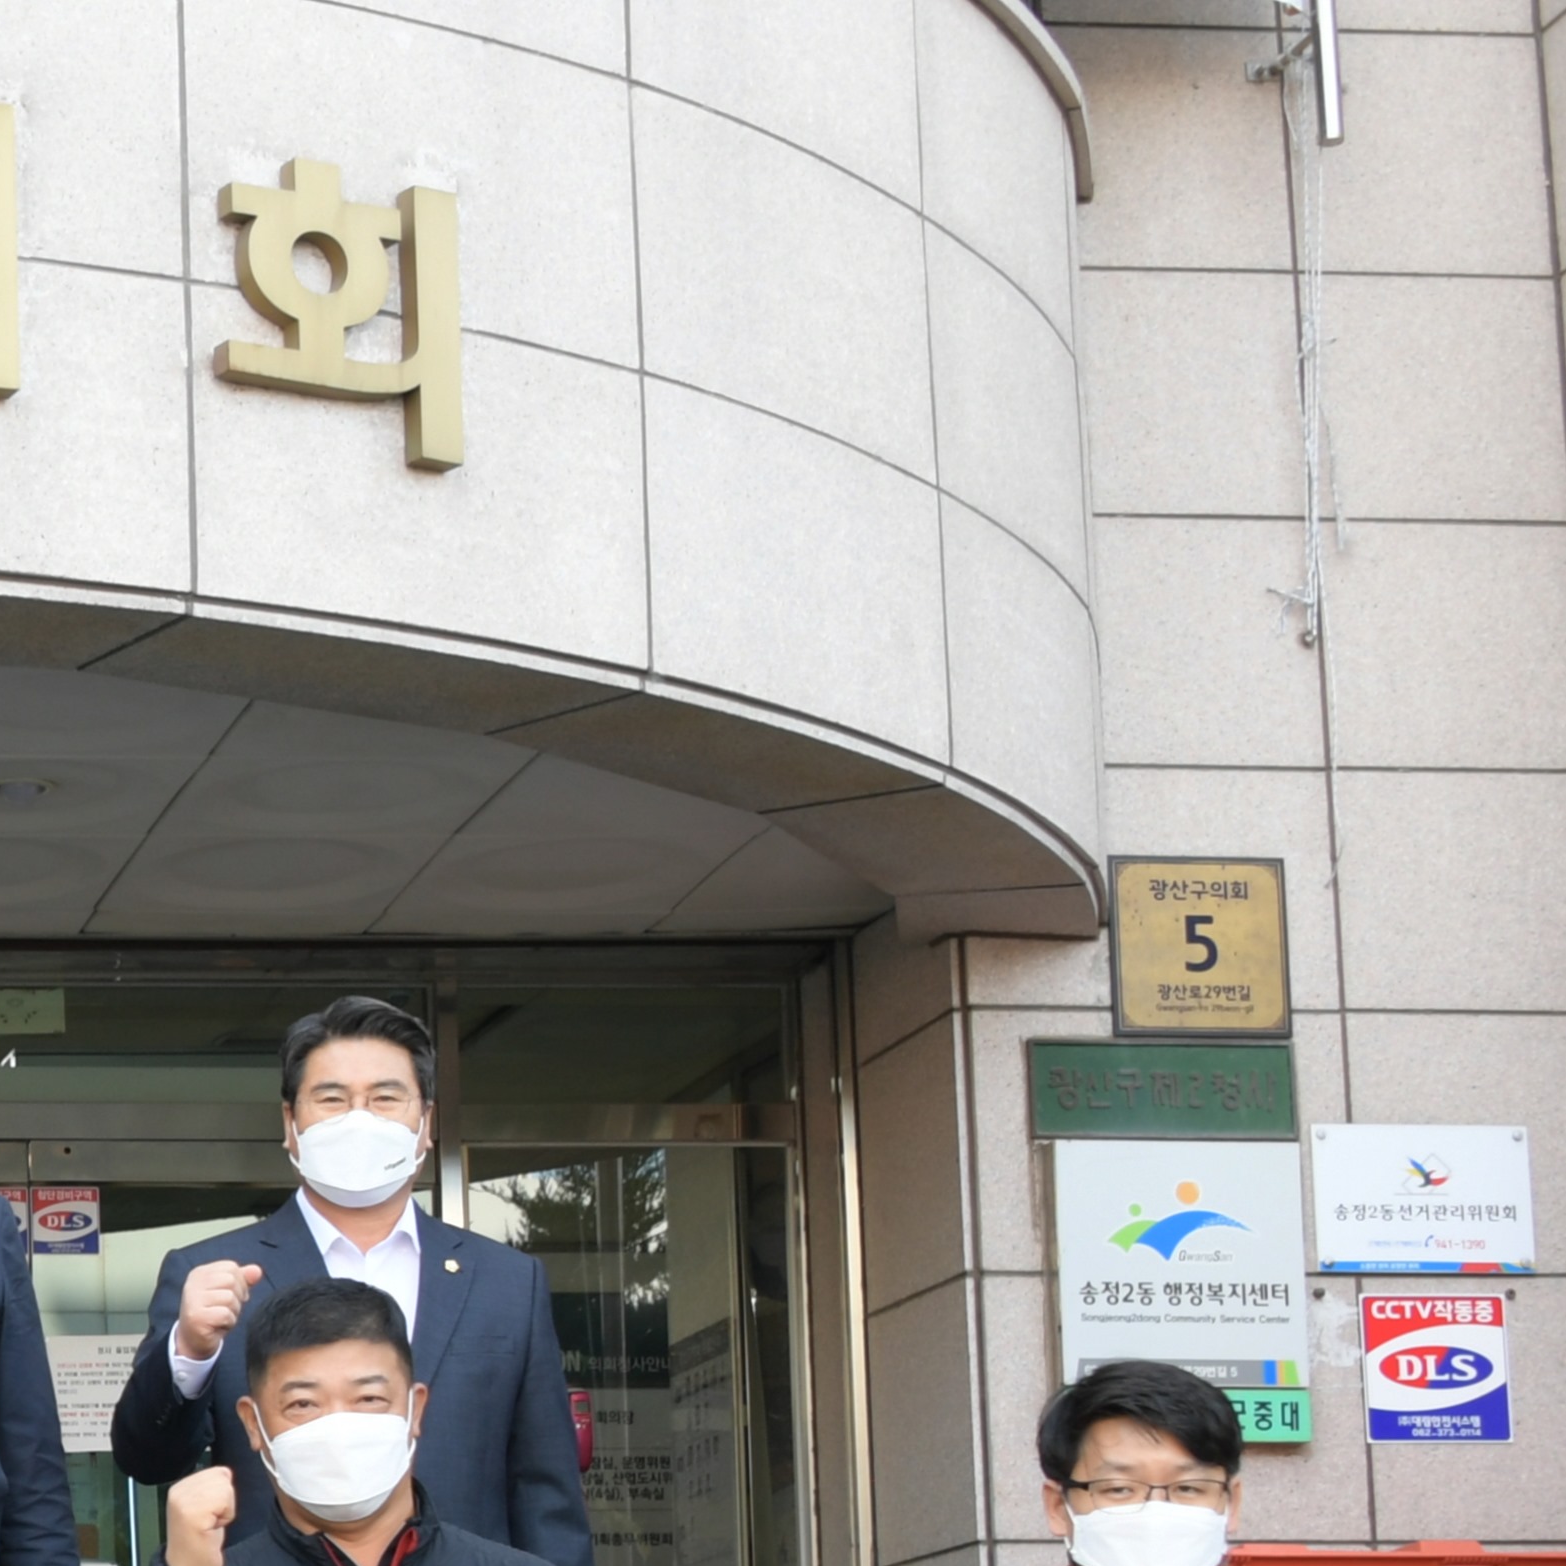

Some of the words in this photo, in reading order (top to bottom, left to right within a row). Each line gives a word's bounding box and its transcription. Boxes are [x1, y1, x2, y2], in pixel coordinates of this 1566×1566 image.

[1148, 878, 1249, 901] 광산구의회
[1184, 914, 1219, 973] 5
[1156, 983, 1252, 1002] 광산로29번길
[46, 1214, 86, 1228] DLS
[1078, 1280, 1157, 1307] 송정2동
[1163, 1281, 1291, 1308] 행정복지센터
[1080, 1312, 1161, 1324] Songjeong2dong
[1163, 1313, 1217, 1325] Community
[1219, 1314, 1256, 1324] Service
[1258, 1314, 1291, 1324] Center
[1370, 1300, 1494, 1323] CCTV작동중
[1395, 1354, 1479, 1381] DLS
